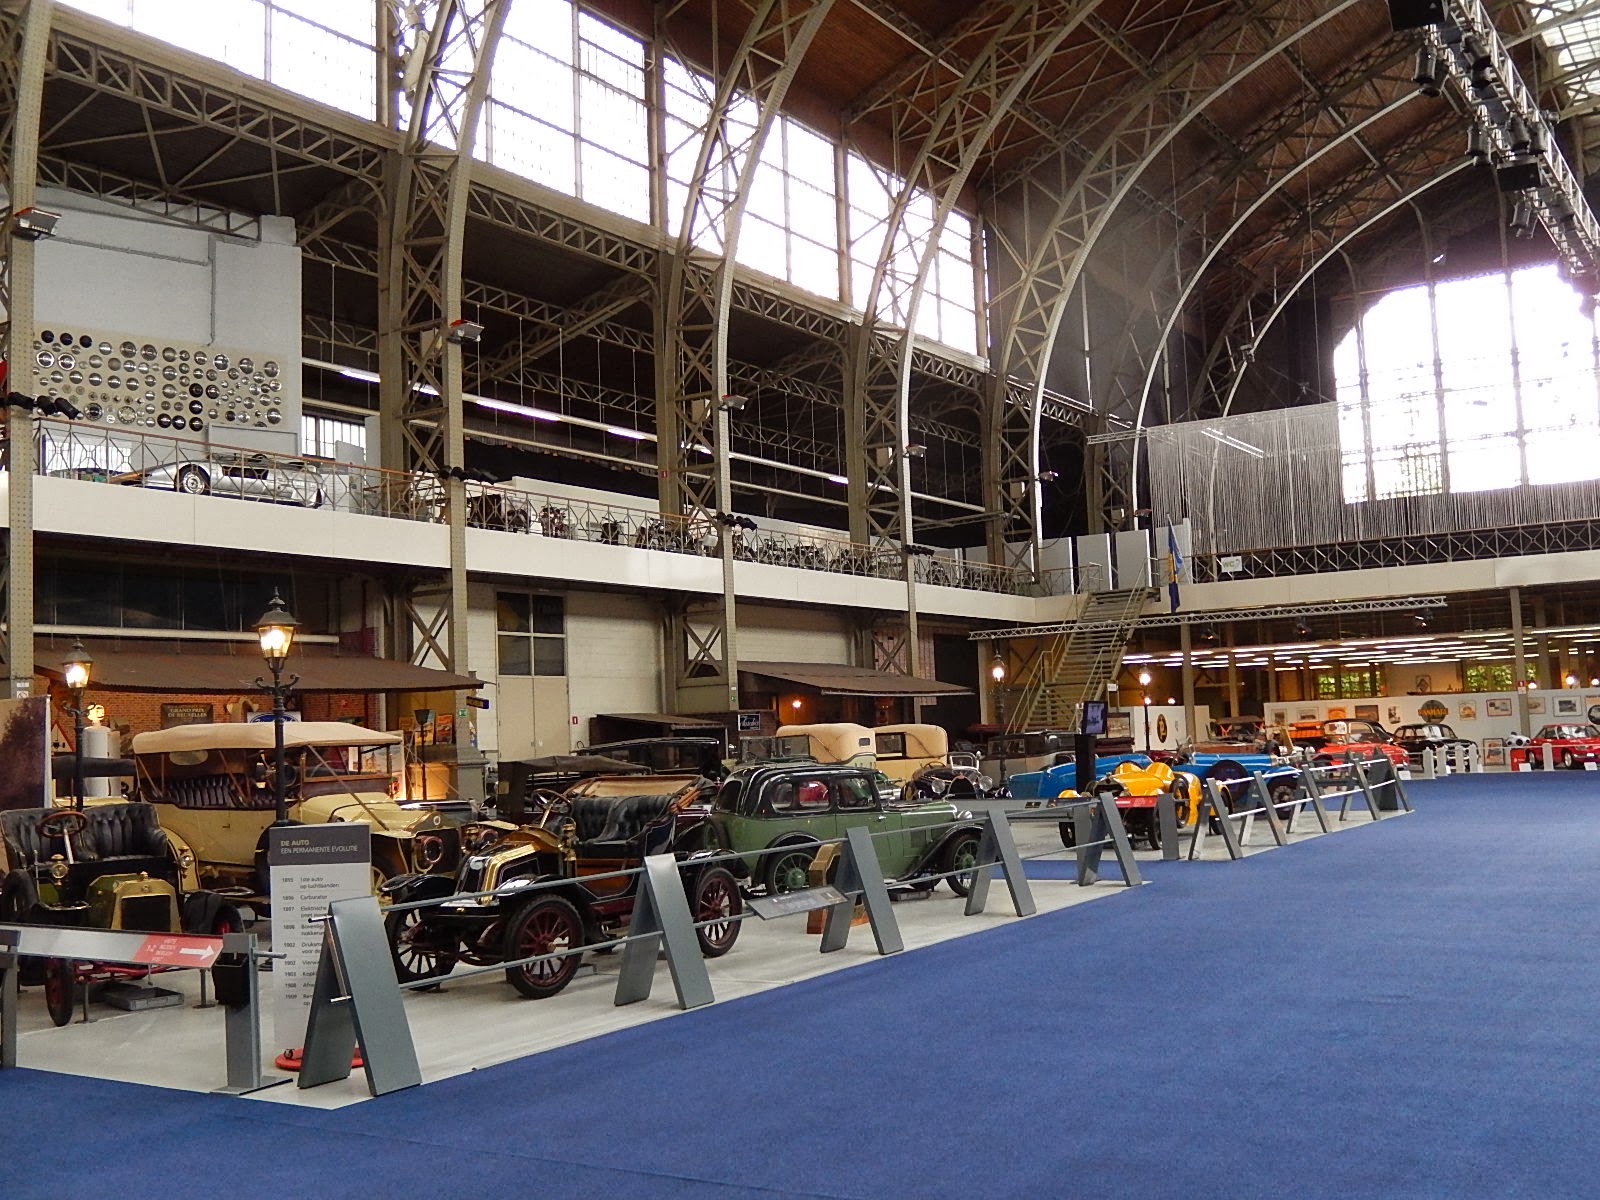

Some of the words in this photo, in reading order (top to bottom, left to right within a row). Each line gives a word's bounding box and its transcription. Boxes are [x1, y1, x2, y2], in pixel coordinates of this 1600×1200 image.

[280, 847, 292, 855] EEN
[292, 845, 330, 854] PERMANENTE
[332, 844, 358, 853] EVOLUTIE
